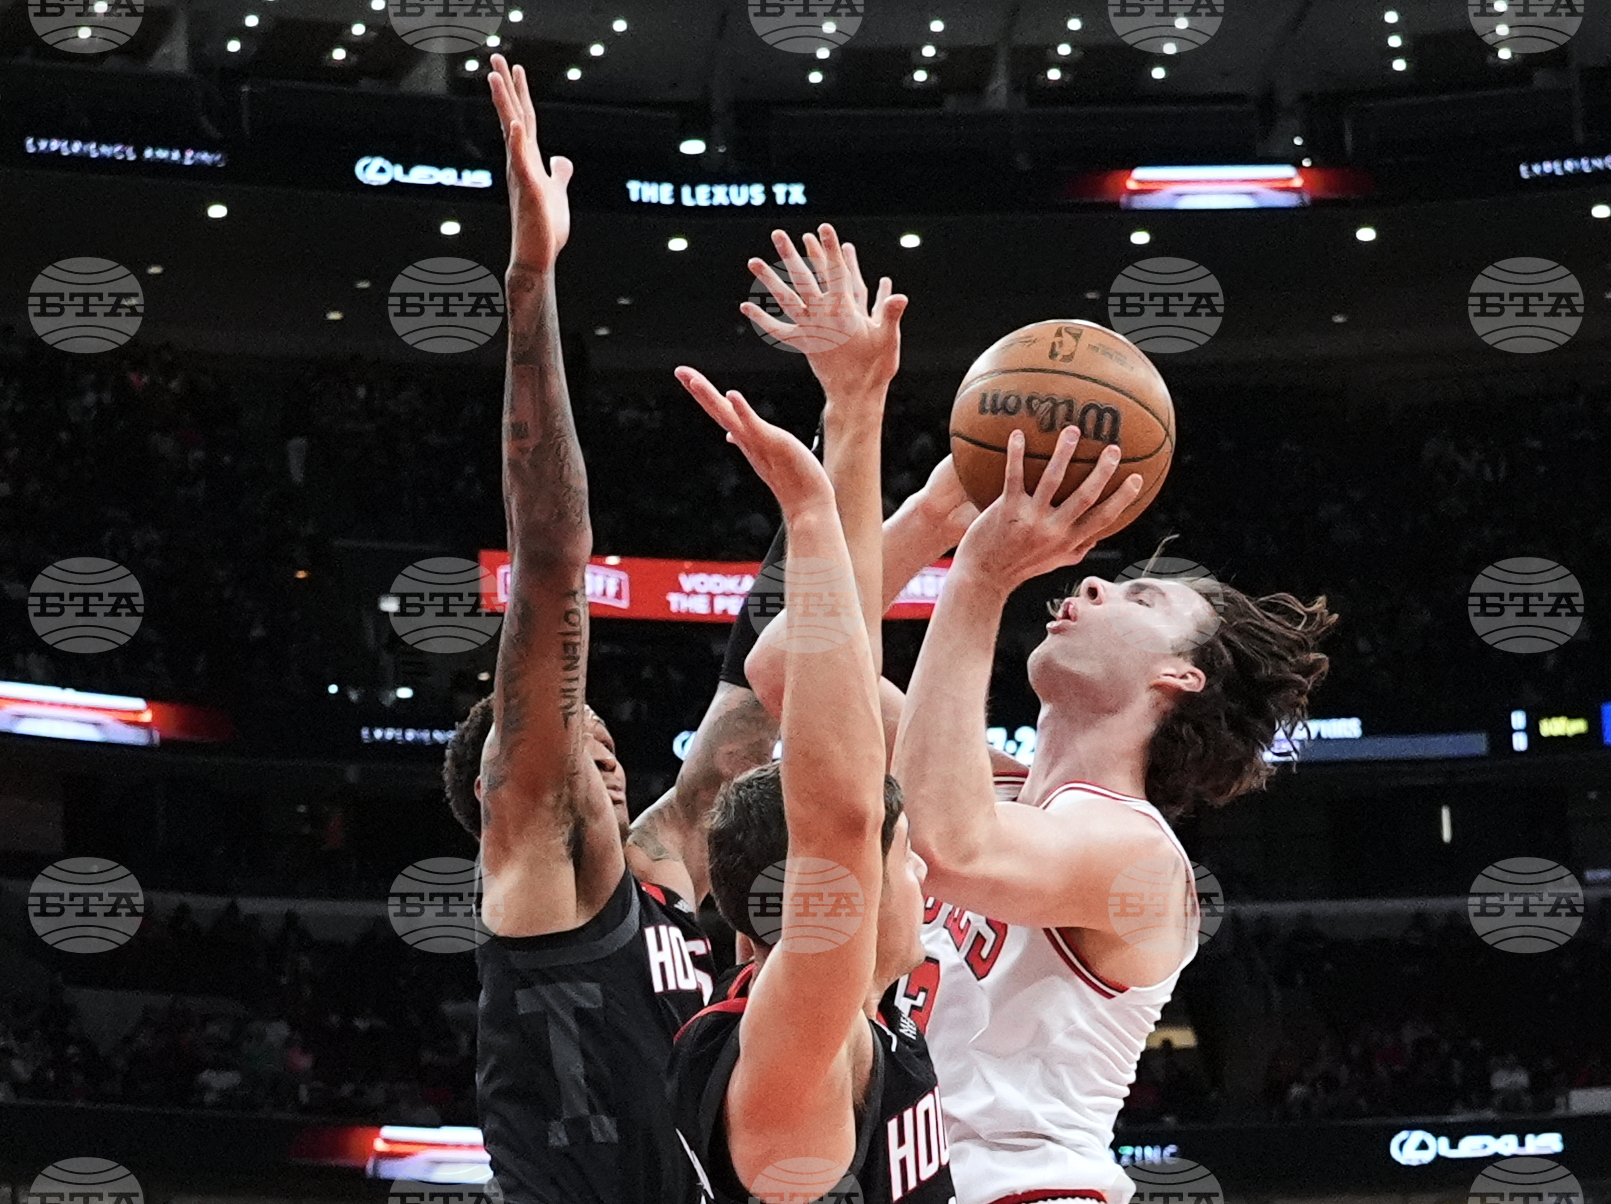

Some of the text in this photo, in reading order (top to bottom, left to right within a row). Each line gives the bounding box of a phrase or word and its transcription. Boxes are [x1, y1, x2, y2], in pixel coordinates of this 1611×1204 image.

[393, 164, 493, 188] LEXUS
[626, 180, 807, 207] THE LEXUS TX
[978, 388, 1122, 447] Wilson
[1437, 1132, 1564, 1159] LEXUS
